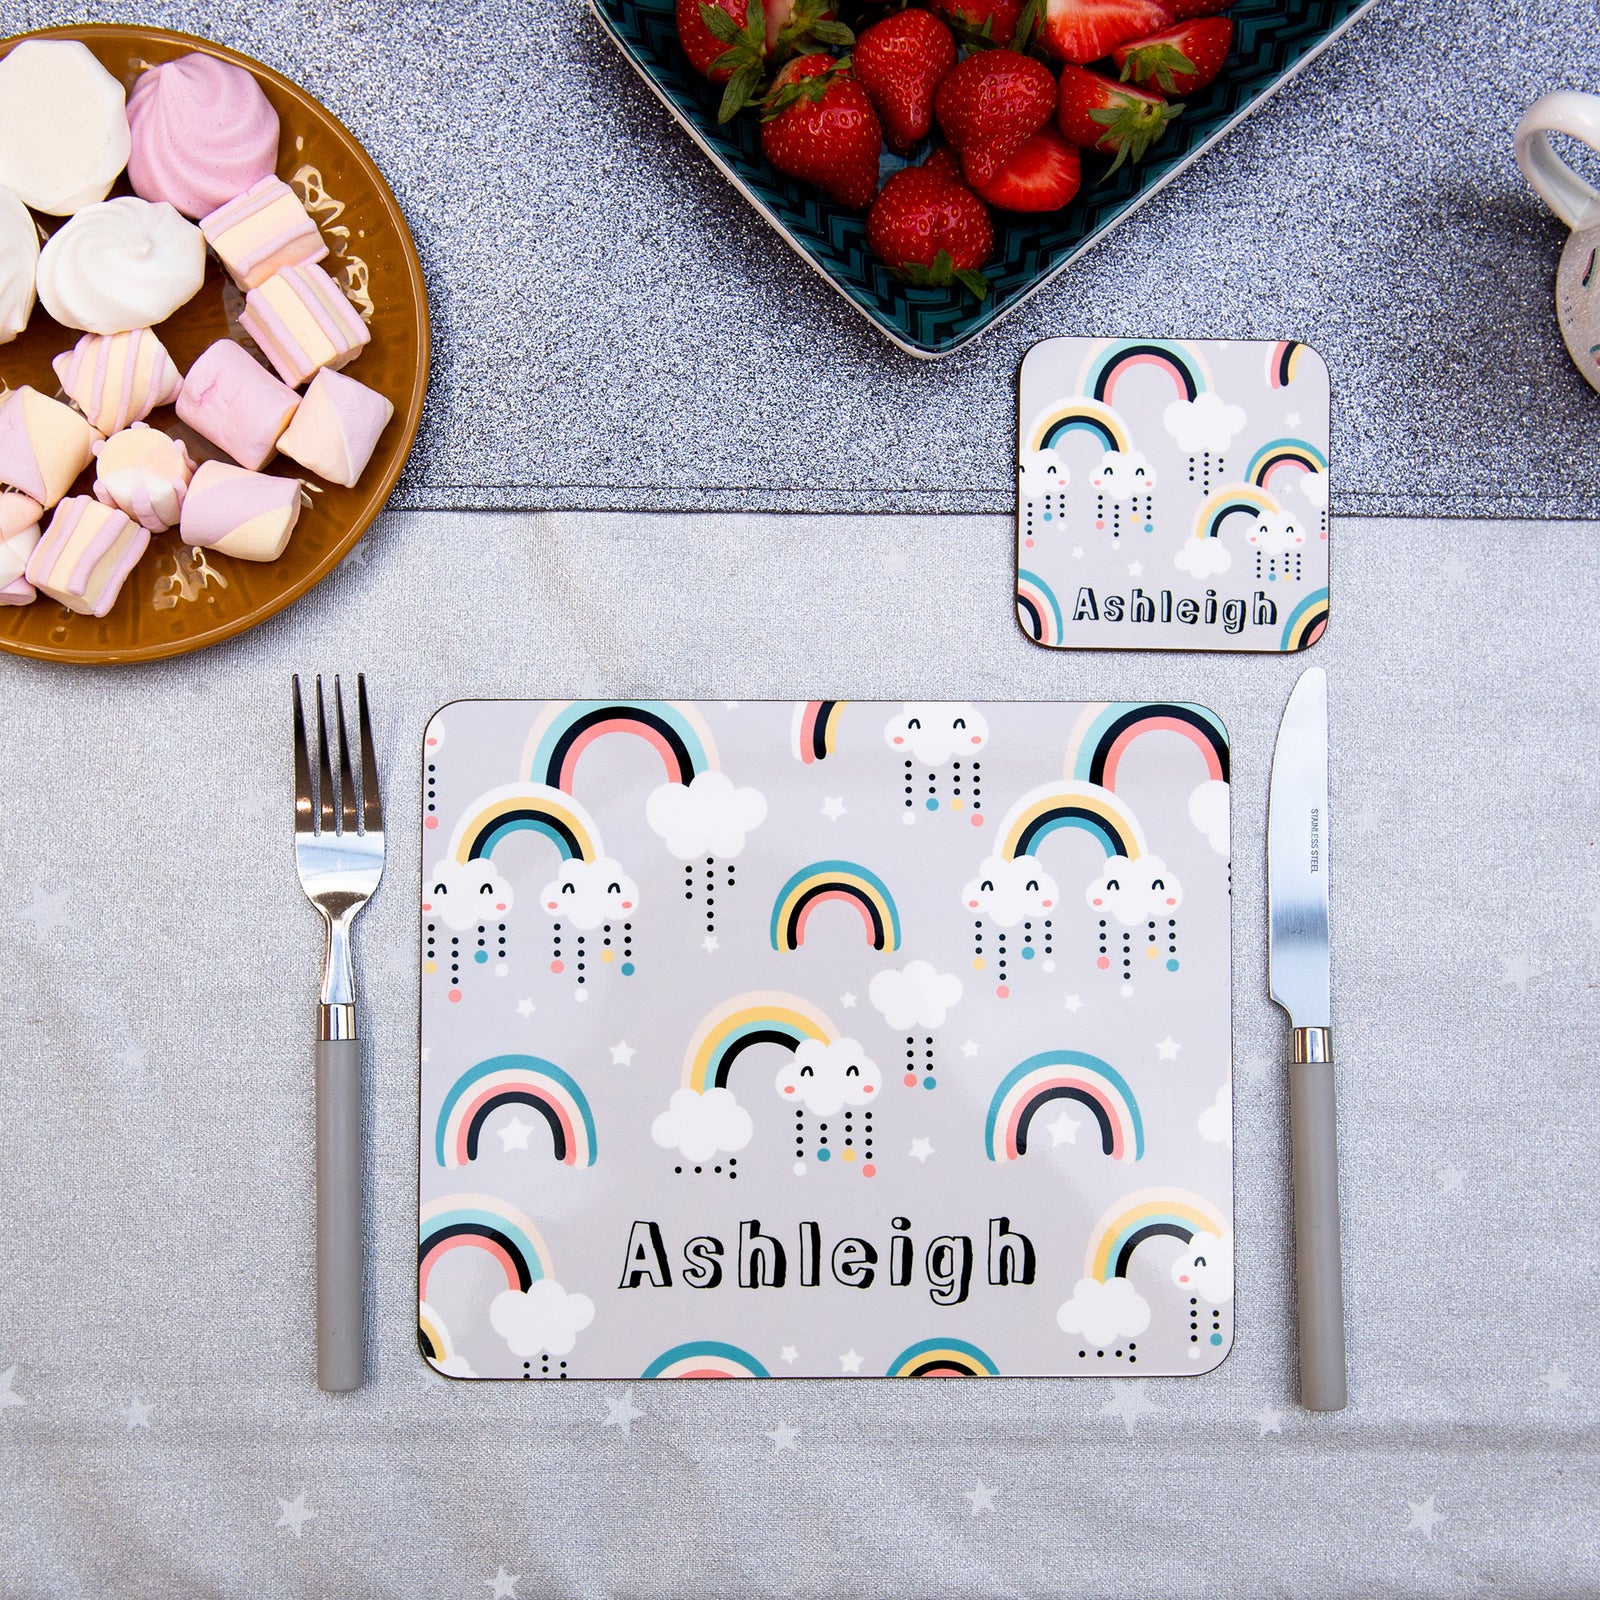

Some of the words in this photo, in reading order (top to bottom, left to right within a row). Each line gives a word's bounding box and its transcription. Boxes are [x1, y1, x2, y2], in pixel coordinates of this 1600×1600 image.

[1072, 587, 1278, 634] Ashleigh
[1310, 808, 1319, 849] STAINLESS
[1310, 850, 1319, 874] STEEL
[618, 1216, 1037, 1306] Ashleigh
